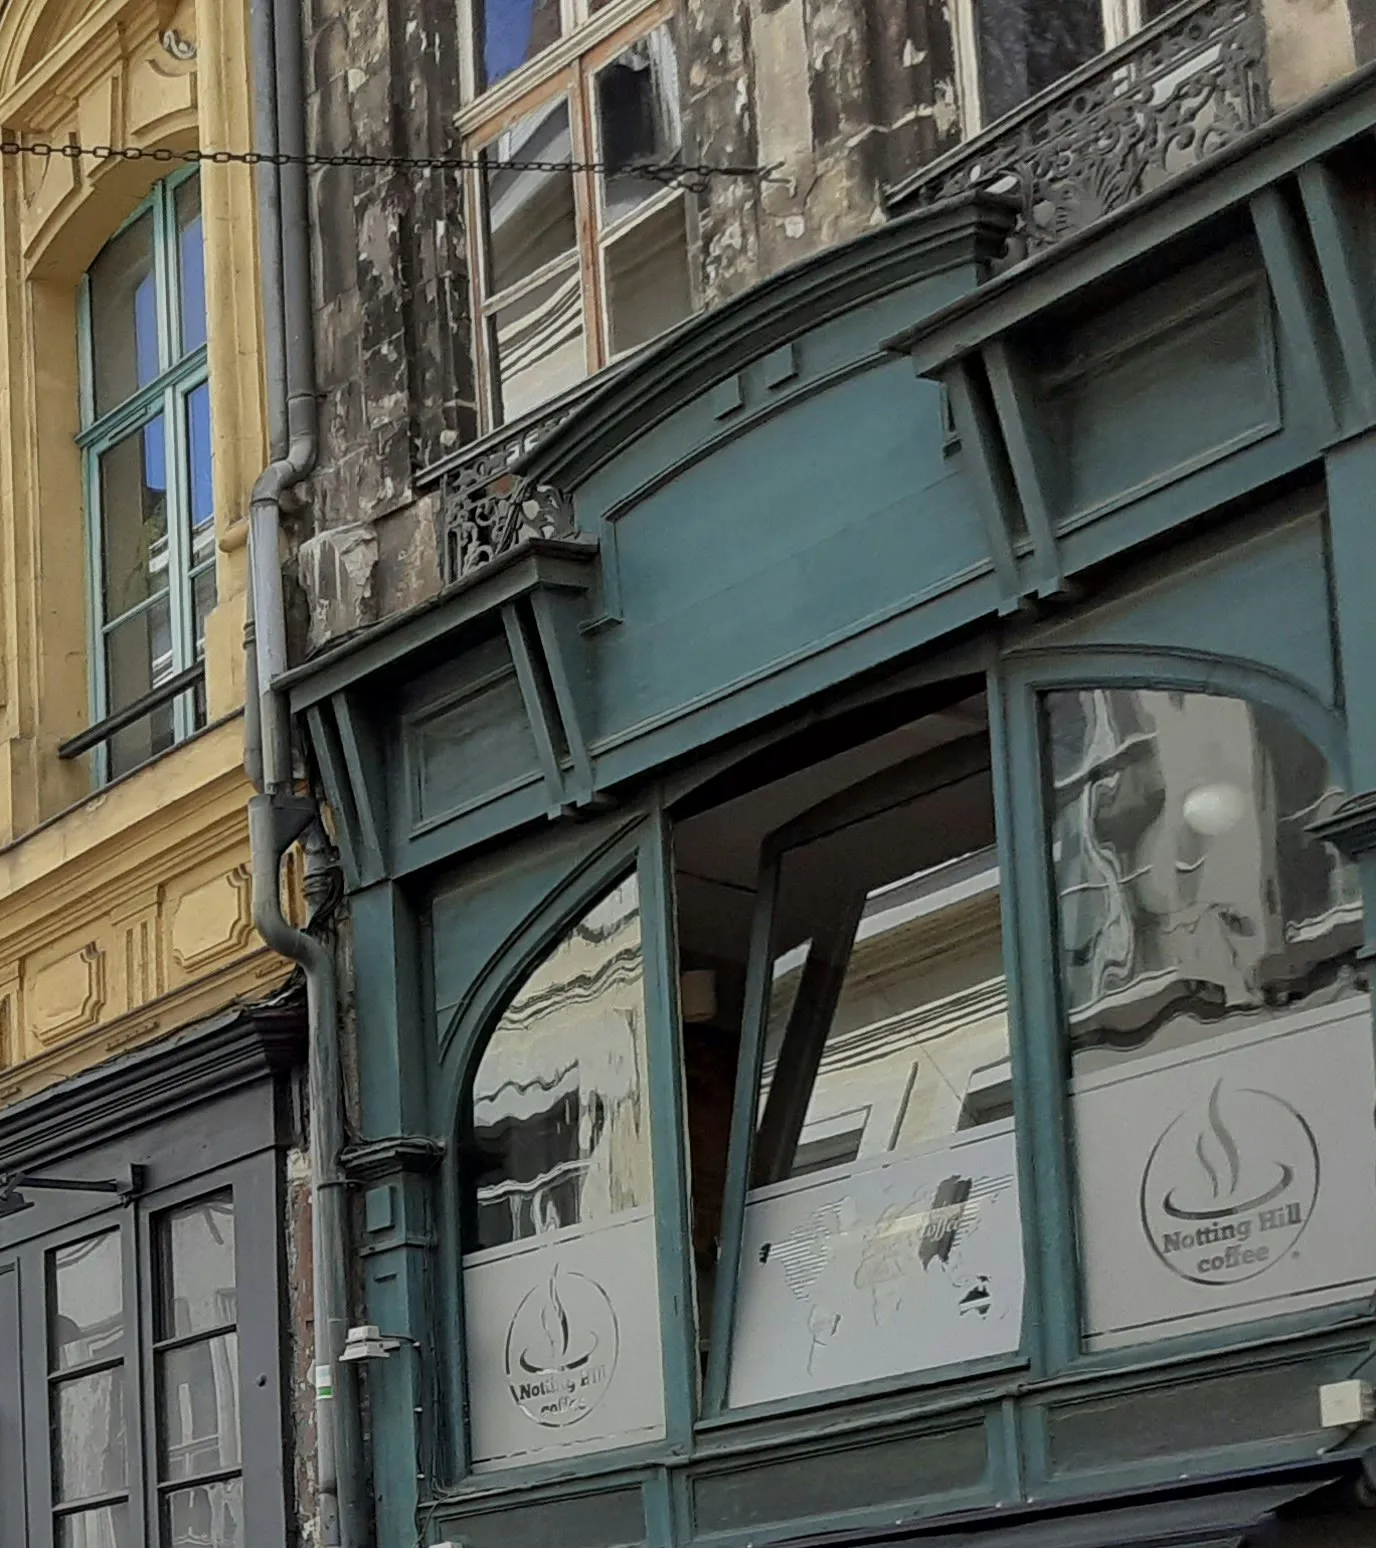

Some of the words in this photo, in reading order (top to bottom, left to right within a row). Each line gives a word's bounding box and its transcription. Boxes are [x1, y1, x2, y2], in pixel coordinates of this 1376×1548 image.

[1161, 1220, 1253, 1254] Notting
[1258, 1202, 1303, 1232] Hill
[1198, 1244, 1270, 1273] coffee
